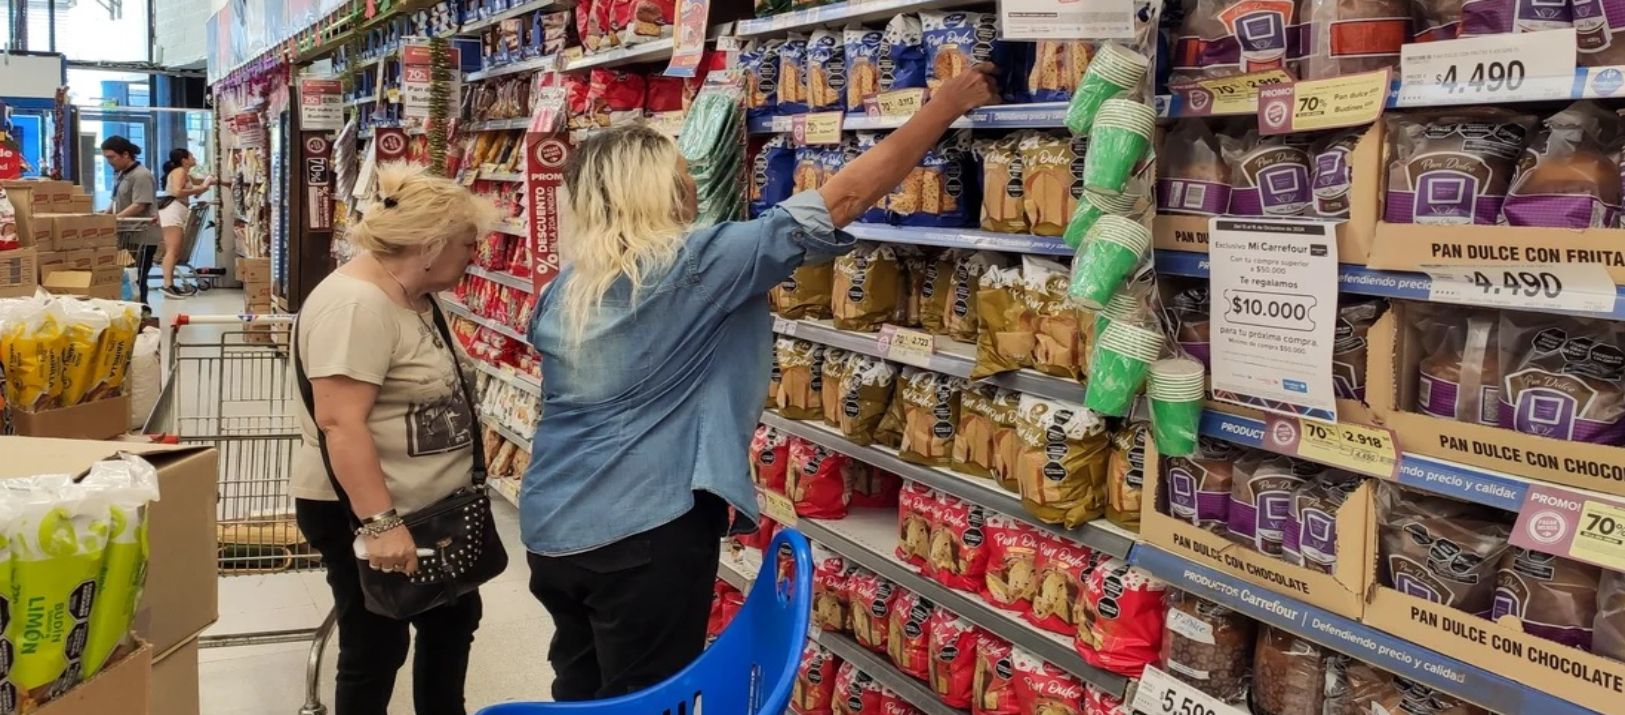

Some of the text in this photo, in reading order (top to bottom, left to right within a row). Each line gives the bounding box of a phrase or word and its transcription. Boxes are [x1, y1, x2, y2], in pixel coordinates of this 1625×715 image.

[1435, 59, 1525, 94] $4.490
[535, 186, 548, 253] DESCUENTO
[1175, 230, 1195, 242] PAN
[1215, 241, 1246, 250] Exclusivo
[1248, 242, 1259, 250] Mi
[1261, 242, 1308, 254] Carrefour
[1253, 257, 1279, 266] compra
[1281, 259, 1309, 267] superior
[1432, 243, 1463, 259] PAN
[1467, 244, 1520, 261] DULCE
[1526, 247, 1560, 263] CON
[1240, 276, 1298, 289] Te regalamos
[1232, 295, 1306, 321] $10.000
[1219, 326, 1237, 336] para
[1239, 328, 1247, 336] tu
[1439, 435, 1625, 481] PAN DULCE CON CHOCO
[1425, 470, 1463, 487] precio
[1464, 480, 1473, 492] y
[1530, 491, 1582, 513] PROMO!
[1173, 533, 1310, 595] PAN DULCE CON CHOCOLATE
[20, 596, 46, 655] LIMÓN
[1183, 569, 1467, 684] PRODUCTOS Carrefour Defendiendo precio y calidad
[1410, 605, 1624, 693] PAN DULCE CON CHOCOLATE
